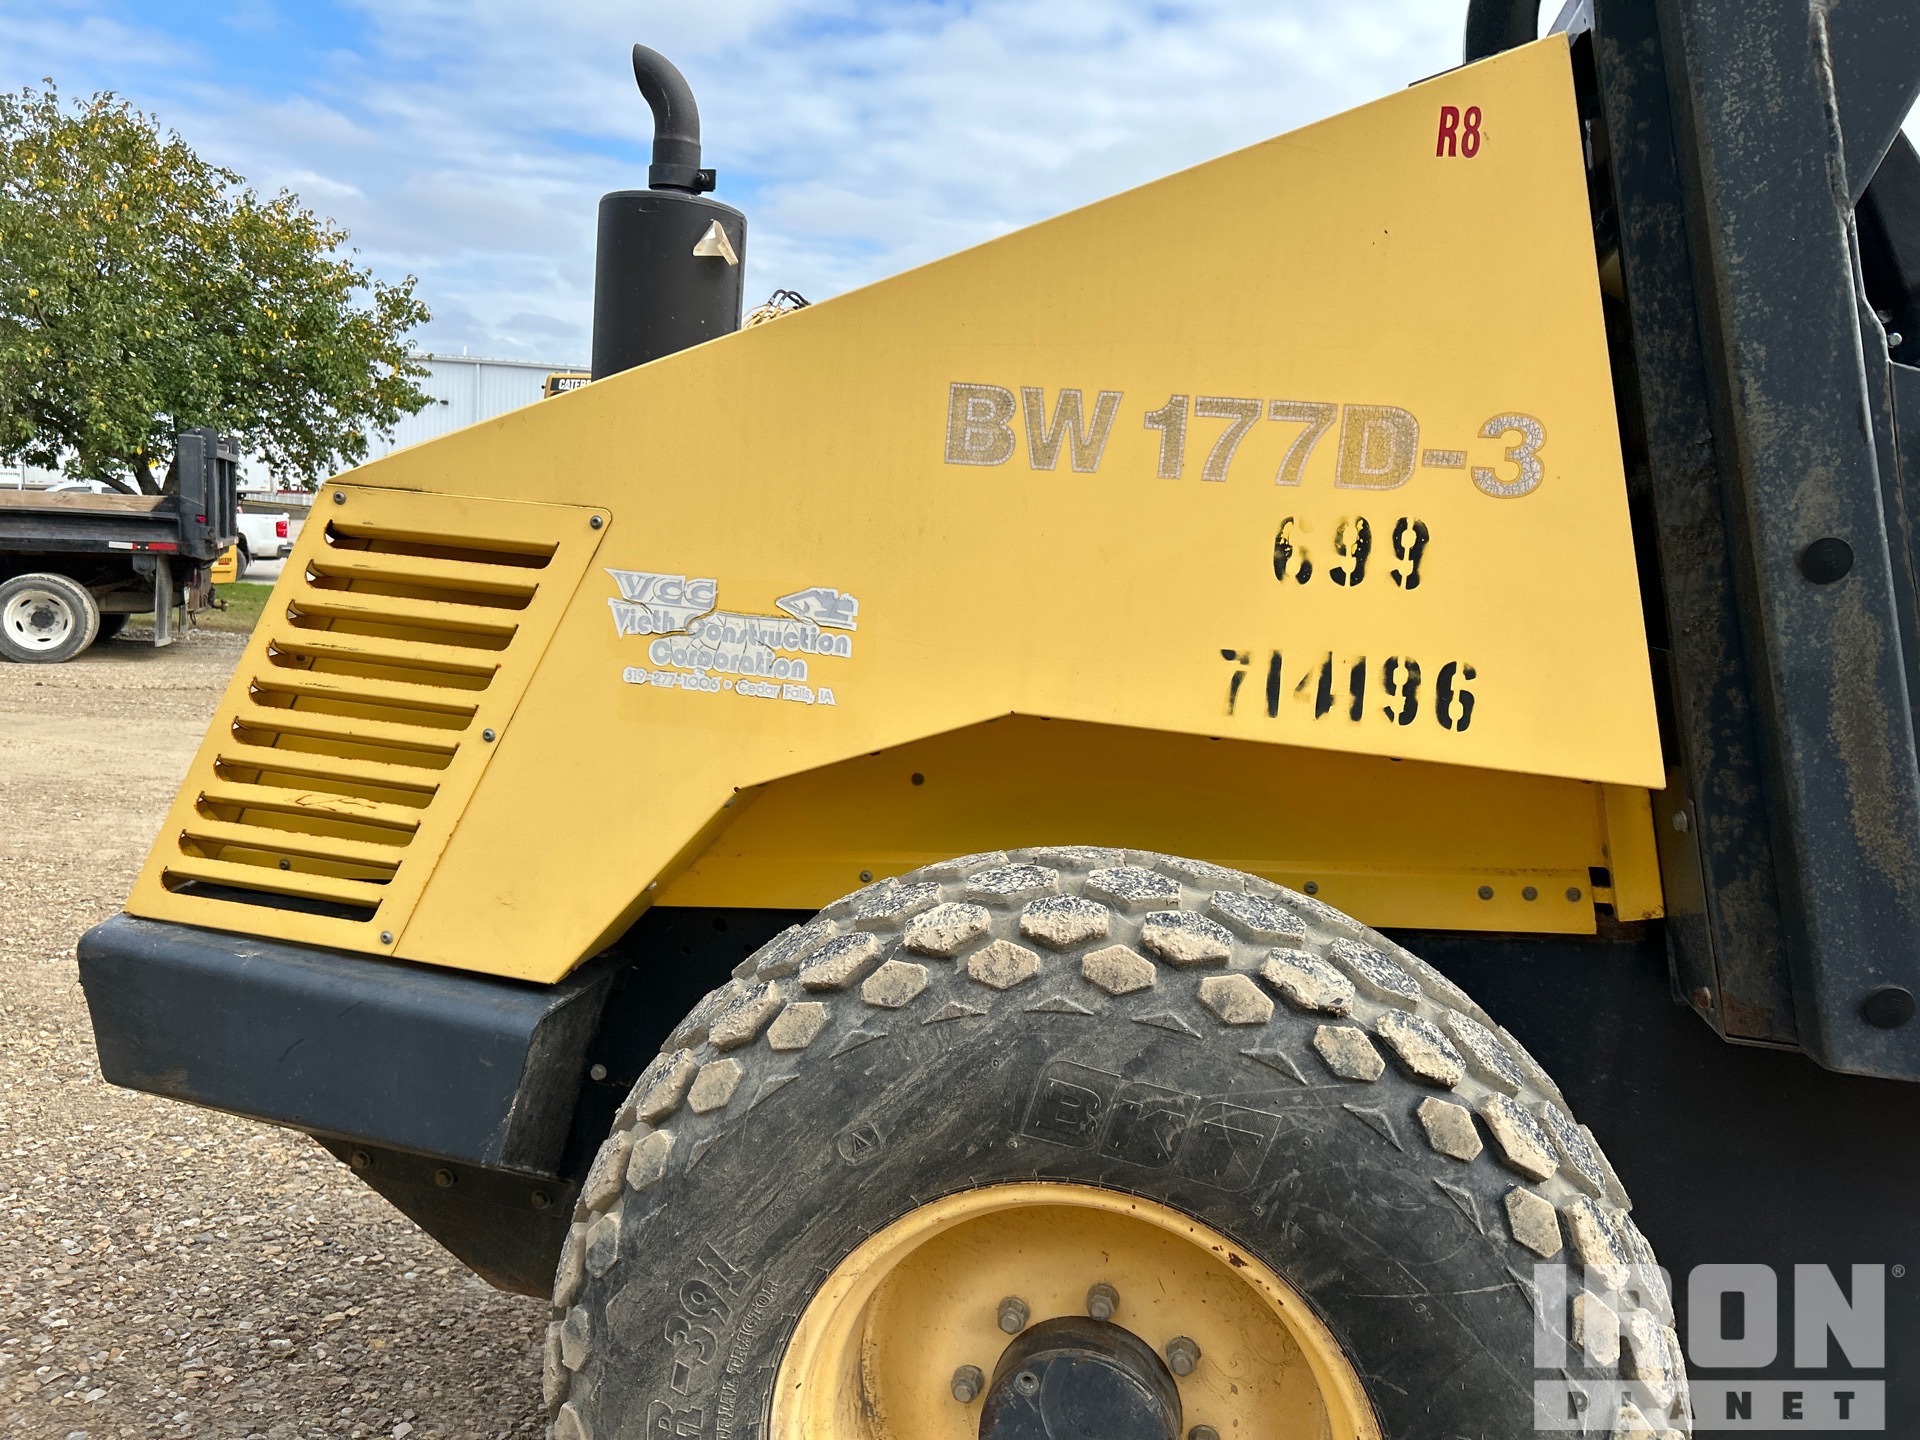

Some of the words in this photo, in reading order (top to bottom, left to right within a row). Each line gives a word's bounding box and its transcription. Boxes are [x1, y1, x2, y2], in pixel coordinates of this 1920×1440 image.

[1436, 106, 1482, 159] R8
[944, 382, 1124, 474] BW
[1143, 394, 1548, 499] 177D-3
[1273, 516, 1430, 590] 699
[613, 572, 715, 609] VCC
[615, 607, 676, 633] Vieth
[684, 613, 849, 655] Construction
[651, 639, 806, 679] Corporation
[625, 667, 721, 691] 319-277-1006
[738, 679, 780, 697] Cedar
[820, 688, 834, 702] IA
[726, 1280, 780, 1374] TRACTOR
